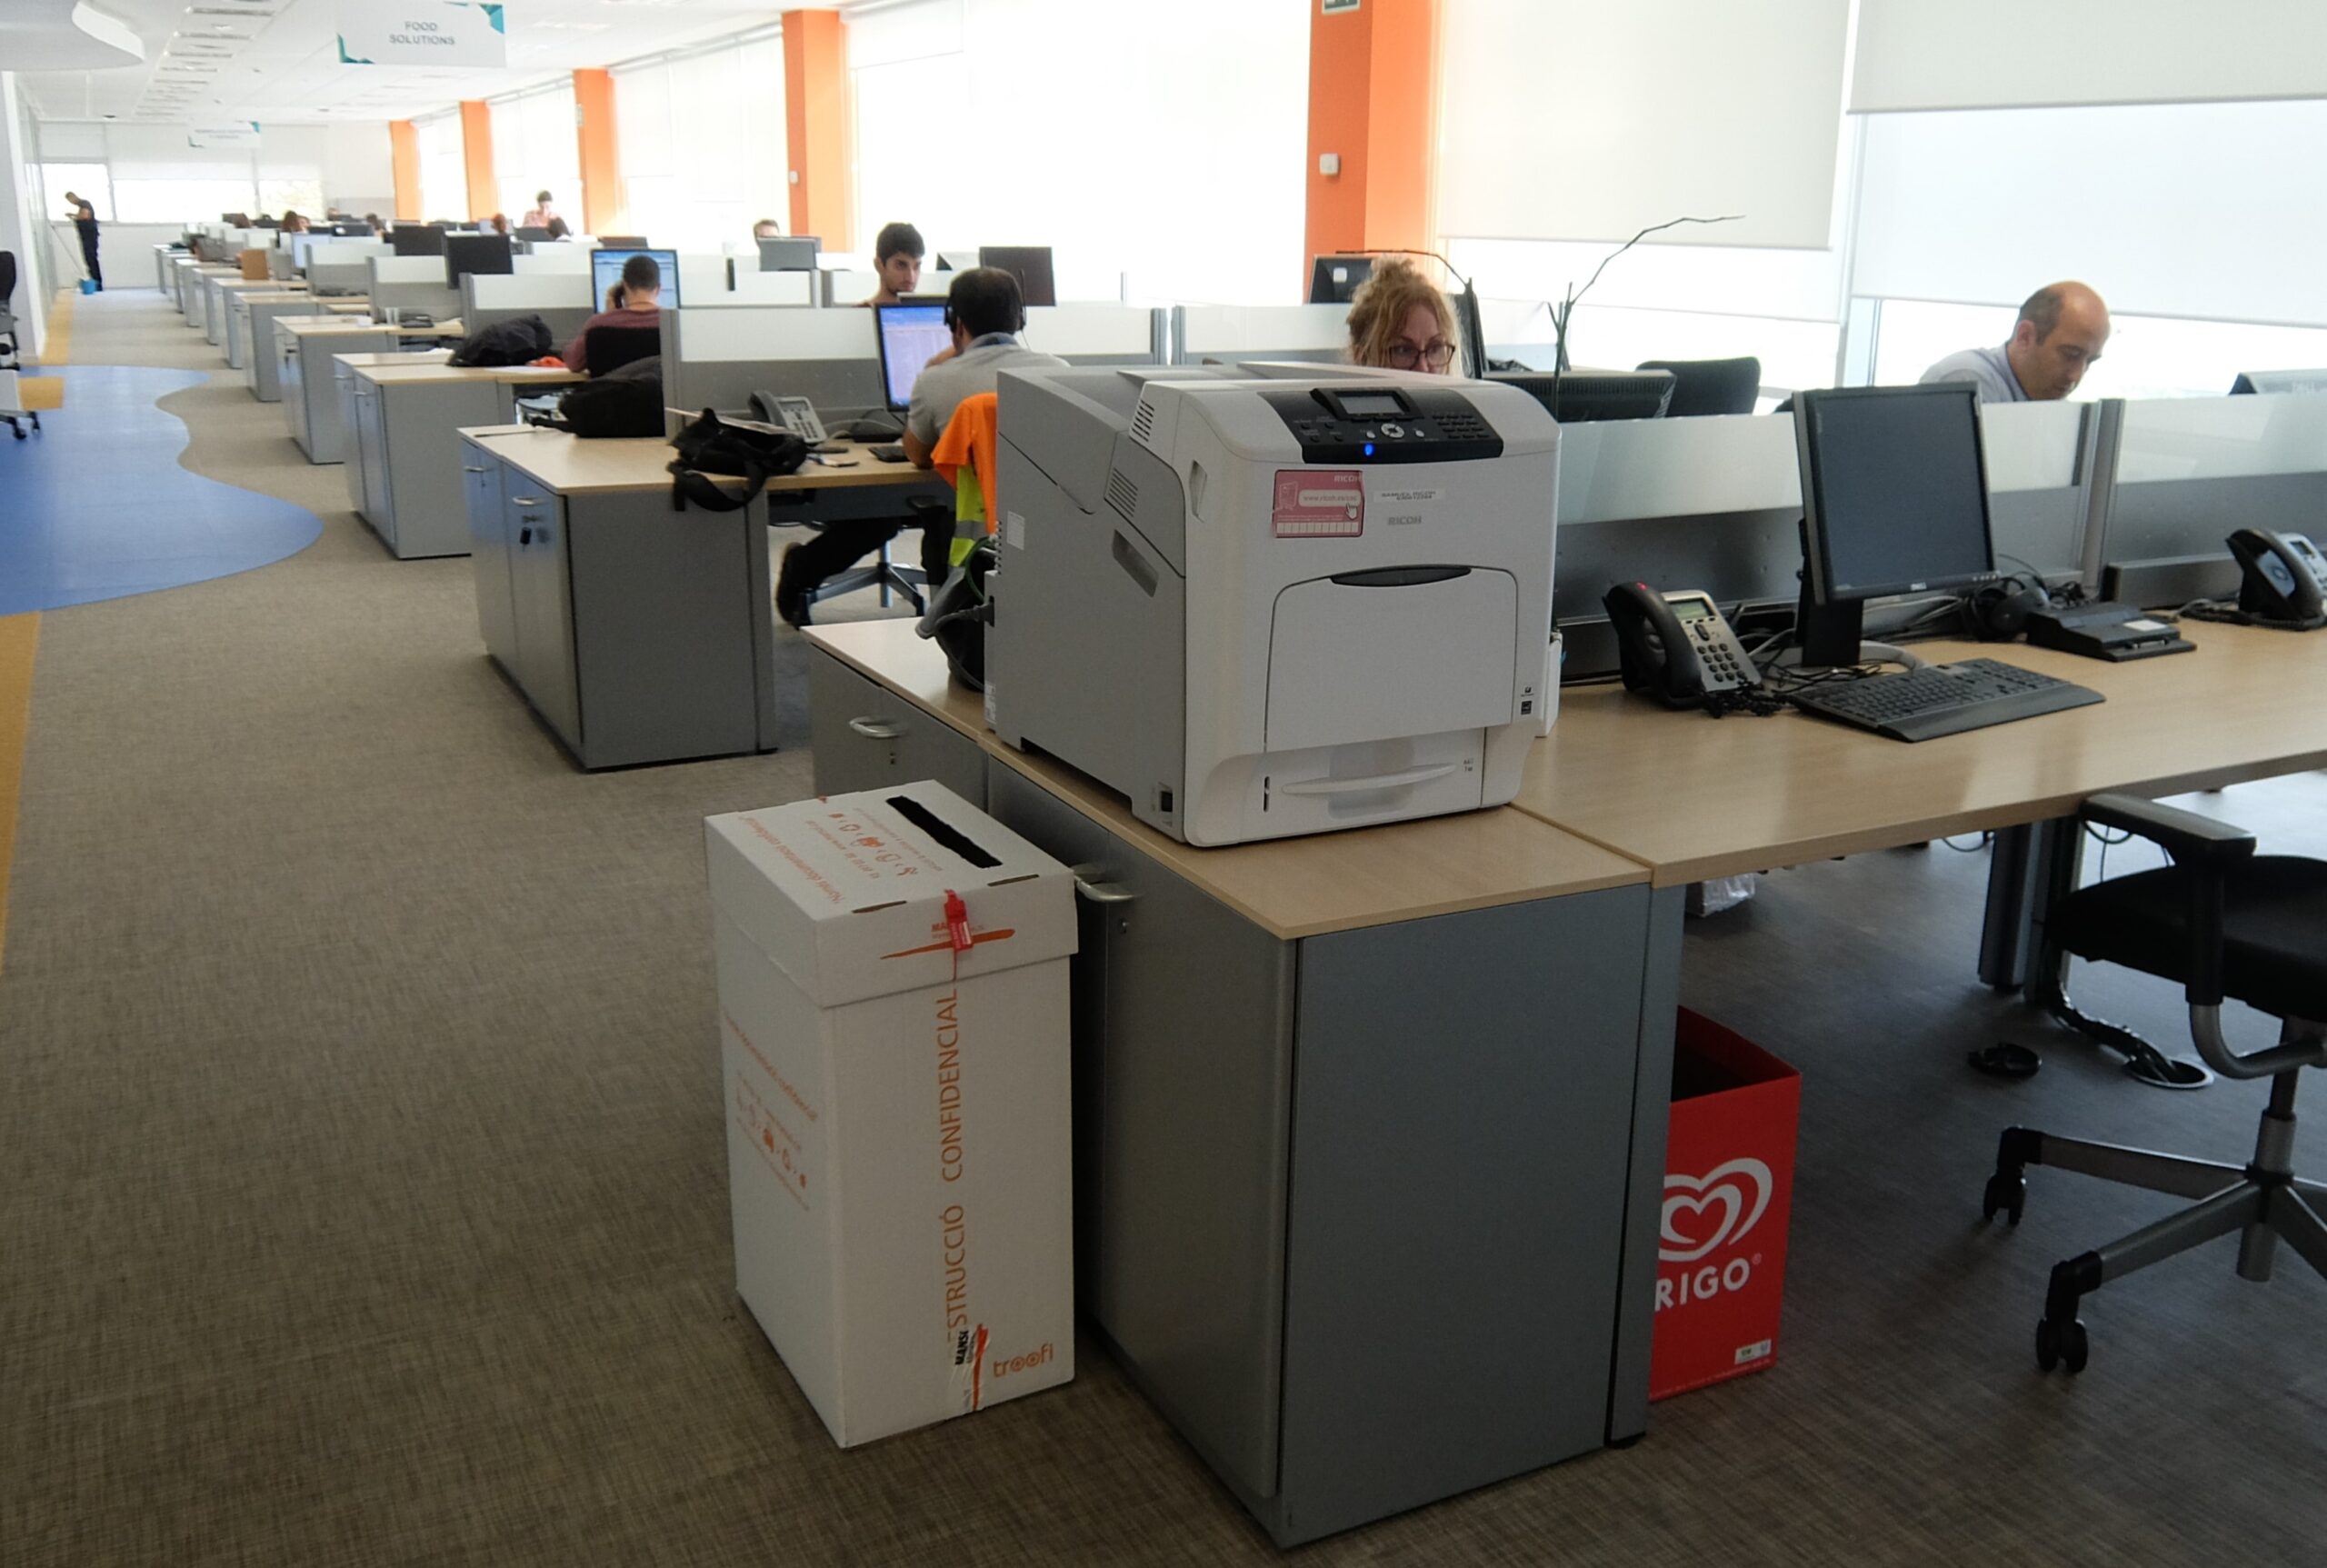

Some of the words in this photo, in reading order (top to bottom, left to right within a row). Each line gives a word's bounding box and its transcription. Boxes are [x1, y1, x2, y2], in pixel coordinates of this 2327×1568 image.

[389, 34, 455, 45] SOLUTIONS
[404, 21, 438, 31] FOOD
[1388, 515, 1422, 525] RICOH
[936, 988, 963, 1182] CONFIDENCIAL
[939, 1204, 968, 1343] STRUCCIÓ
[1653, 1258, 1751, 1312] RIGO
[993, 1342, 1054, 1378] troofi
